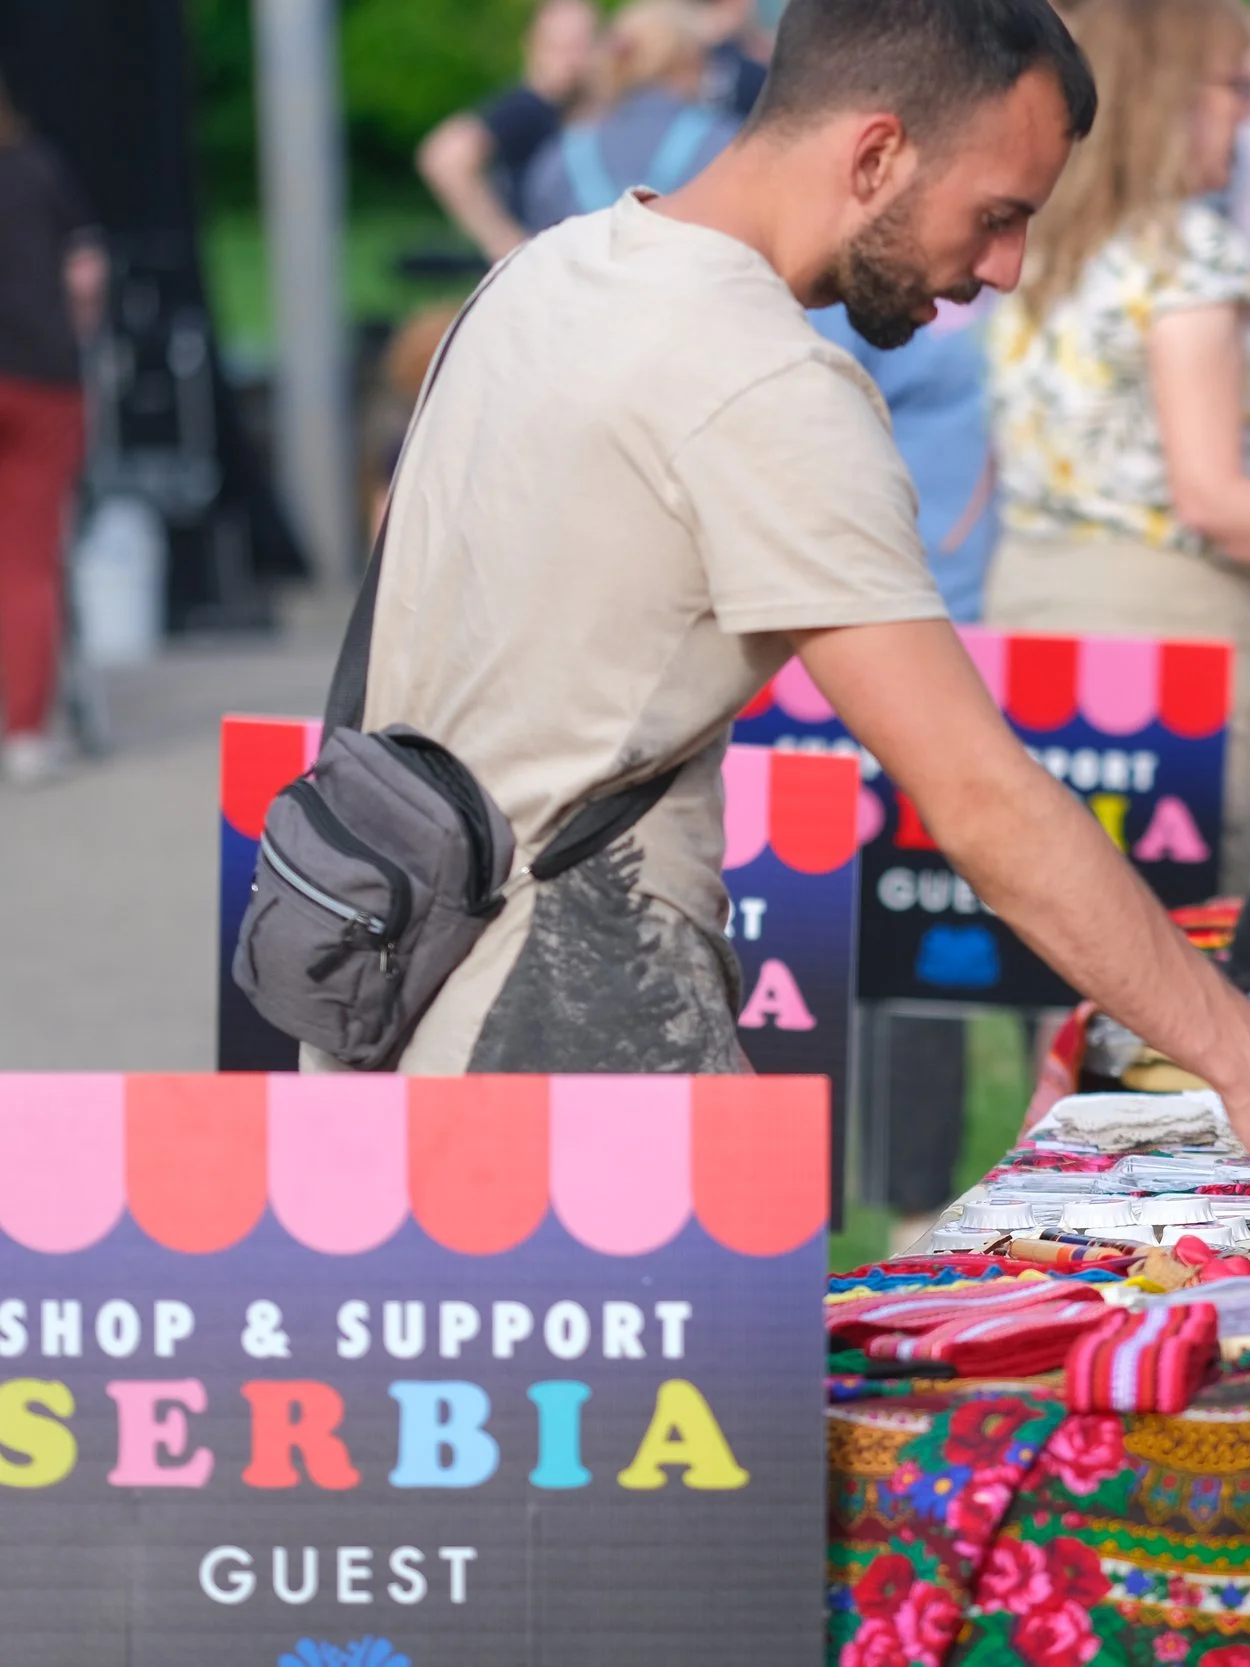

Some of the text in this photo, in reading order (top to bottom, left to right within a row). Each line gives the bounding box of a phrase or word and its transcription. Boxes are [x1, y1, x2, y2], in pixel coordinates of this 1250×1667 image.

[1026, 746, 1160, 793] PORT
[877, 866, 997, 916] GUE
[0, 1298, 693, 1361] SHOP & SUPPORT
[0, 1376, 751, 1491] SERBIA
[199, 1545, 479, 1604] GUEST
